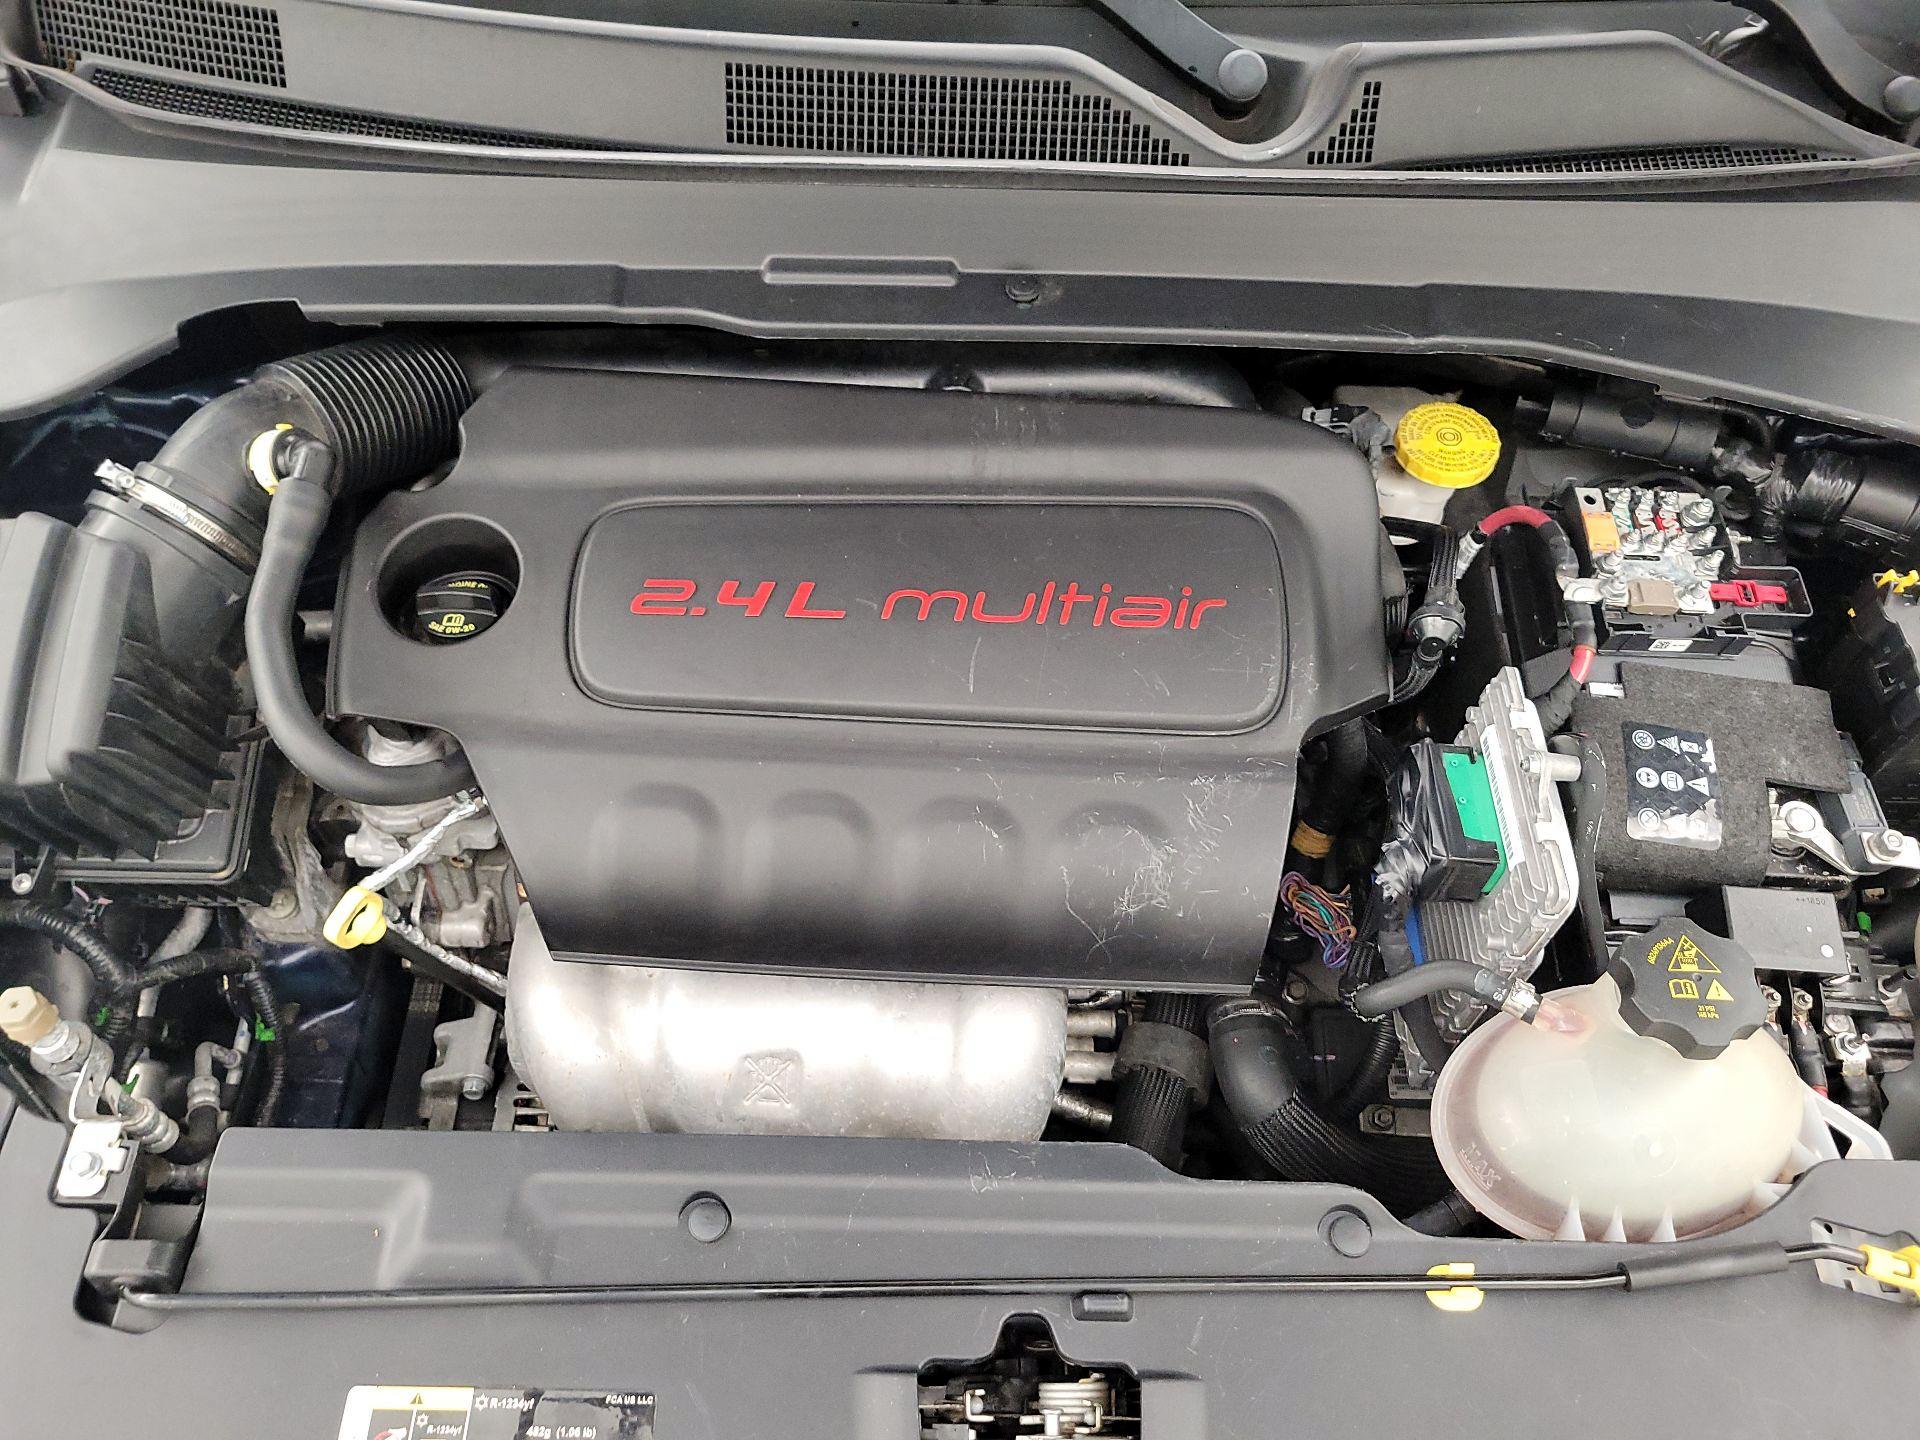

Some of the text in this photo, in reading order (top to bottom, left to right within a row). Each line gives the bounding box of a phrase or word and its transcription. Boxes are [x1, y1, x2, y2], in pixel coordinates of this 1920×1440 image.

[880, 580, 1228, 630] multiair
[605, 1394, 654, 1405] FCA US LLC
